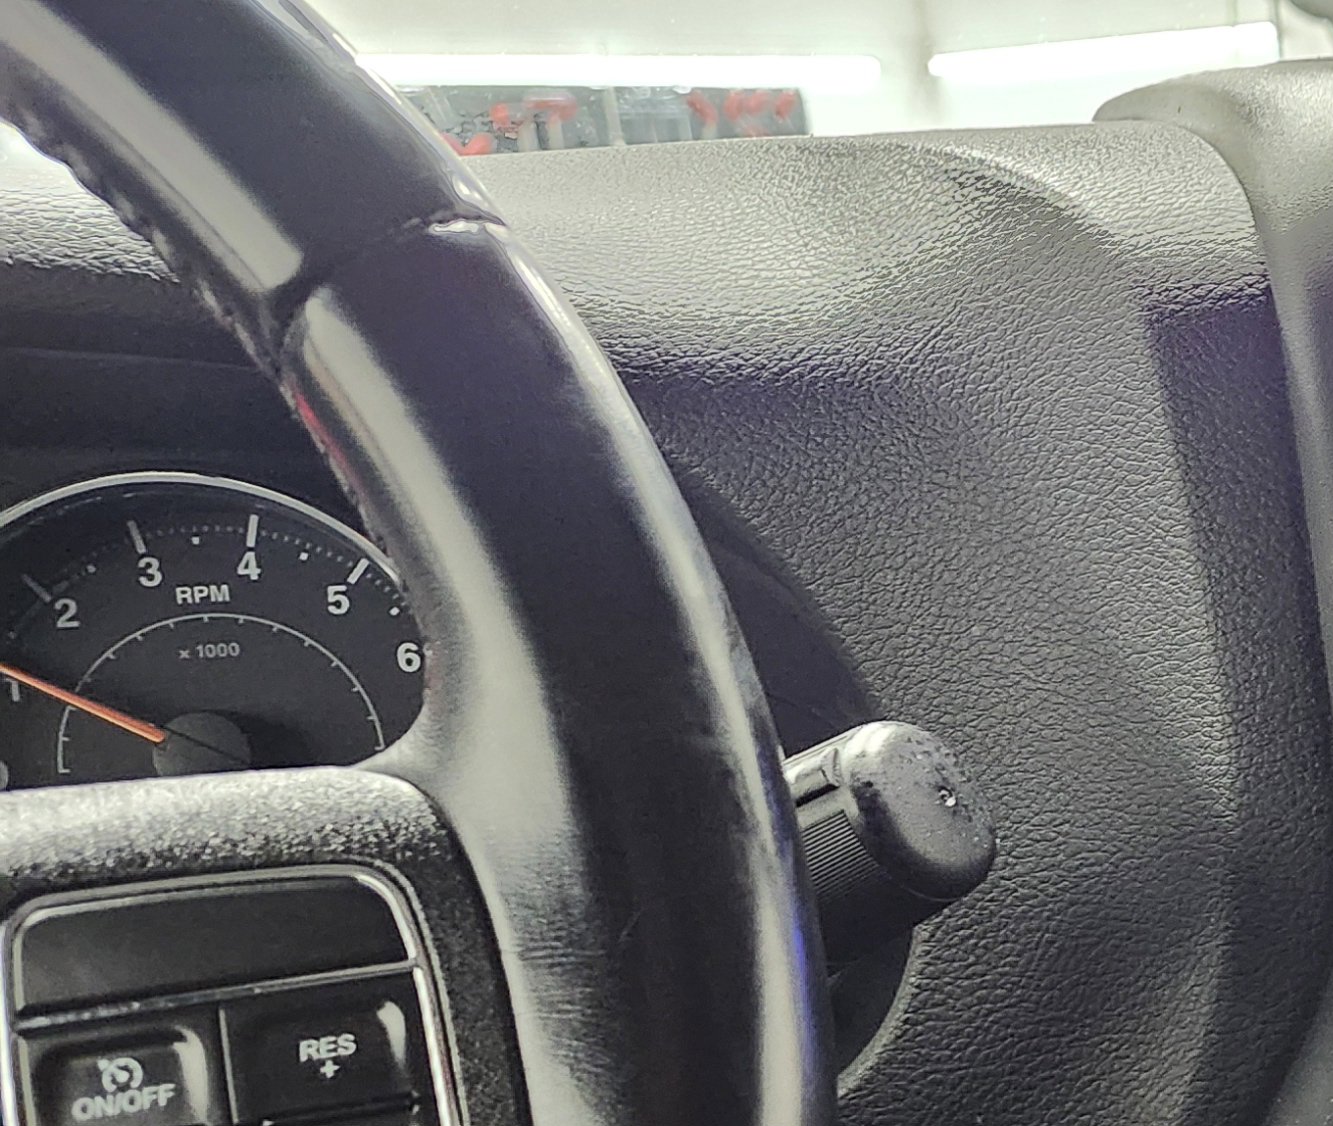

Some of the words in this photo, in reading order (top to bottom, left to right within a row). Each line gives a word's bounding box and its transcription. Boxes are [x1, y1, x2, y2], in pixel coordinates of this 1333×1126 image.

[137, 557, 163, 588] 3
[237, 552, 261, 581] 4
[175, 584, 231, 605] RPM
[326, 585, 351, 615] 5
[54, 599, 81, 629] 2
[195, 642, 240, 659] 1000
[396, 642, 422, 673] 6
[298, 1033, 357, 1063] RES
[71, 1082, 176, 1122] ON/OFF
